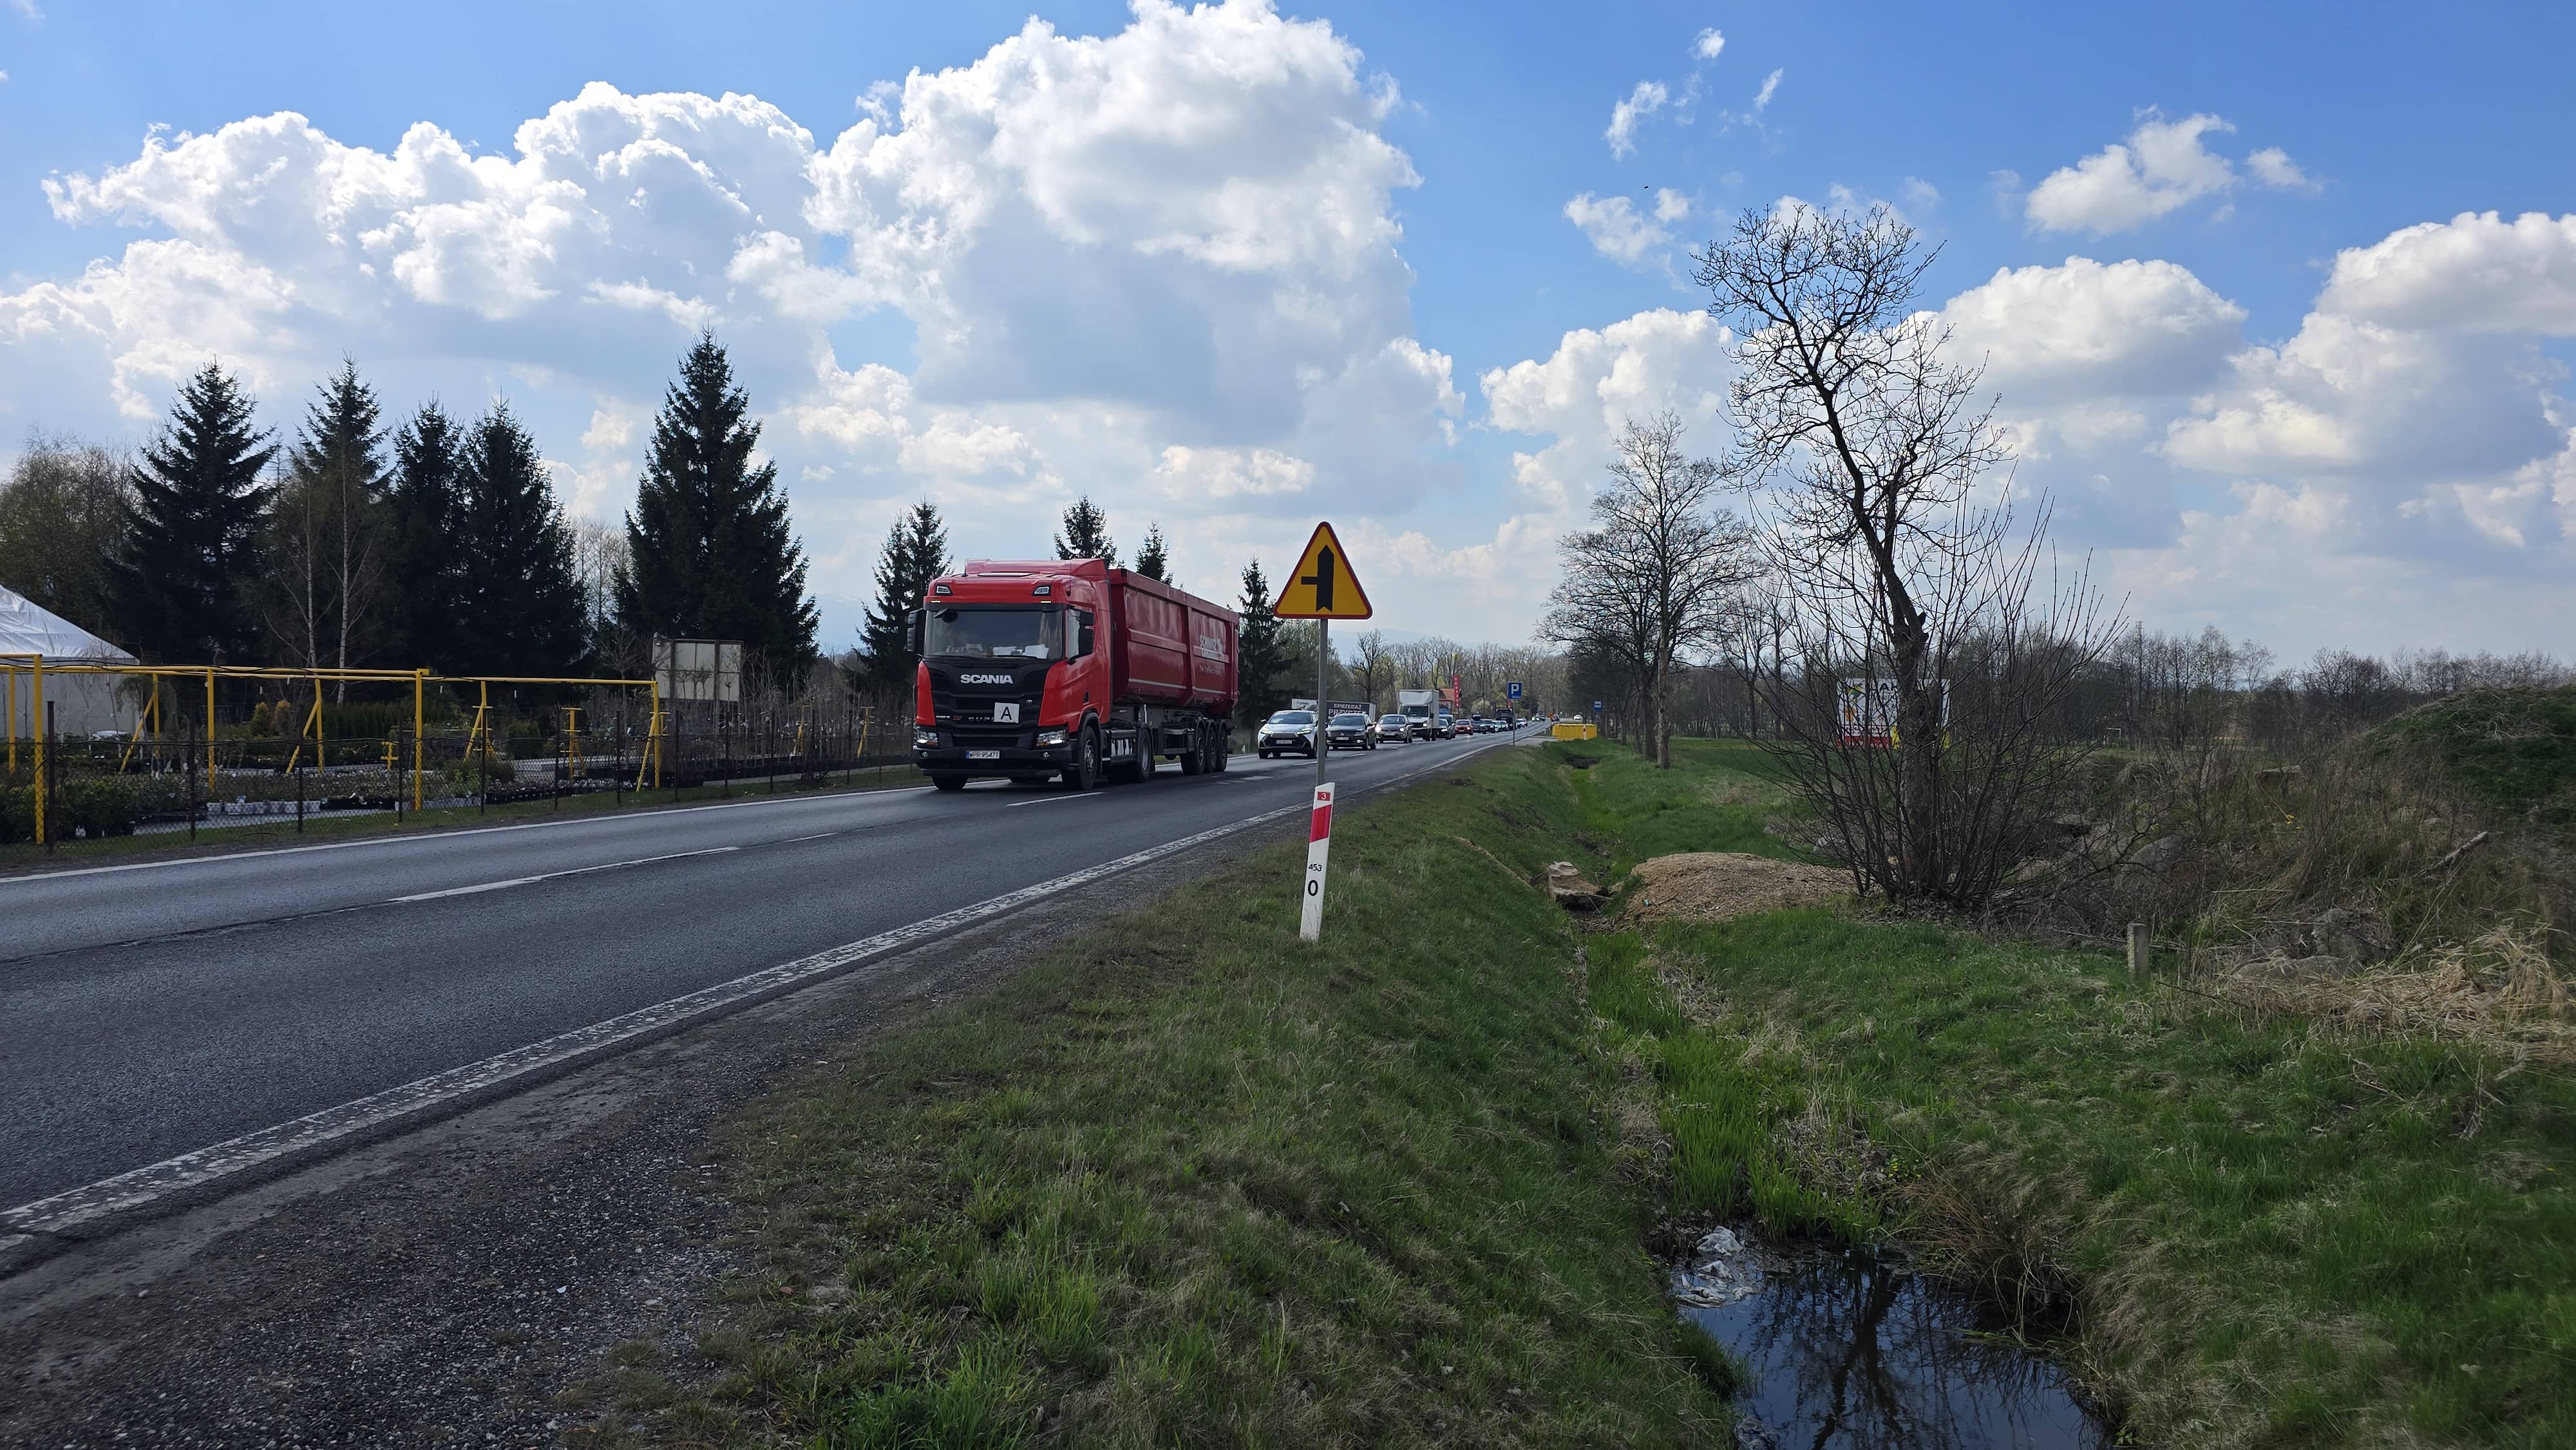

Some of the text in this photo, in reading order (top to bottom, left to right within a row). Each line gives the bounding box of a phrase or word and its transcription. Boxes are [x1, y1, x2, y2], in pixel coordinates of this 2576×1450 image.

[960, 674, 1013, 684] SCANIA
[1511, 684, 1519, 694] P
[1001, 706, 1012, 720] A
[1309, 863, 1322, 872] 453
[1307, 880, 1318, 896] 0
